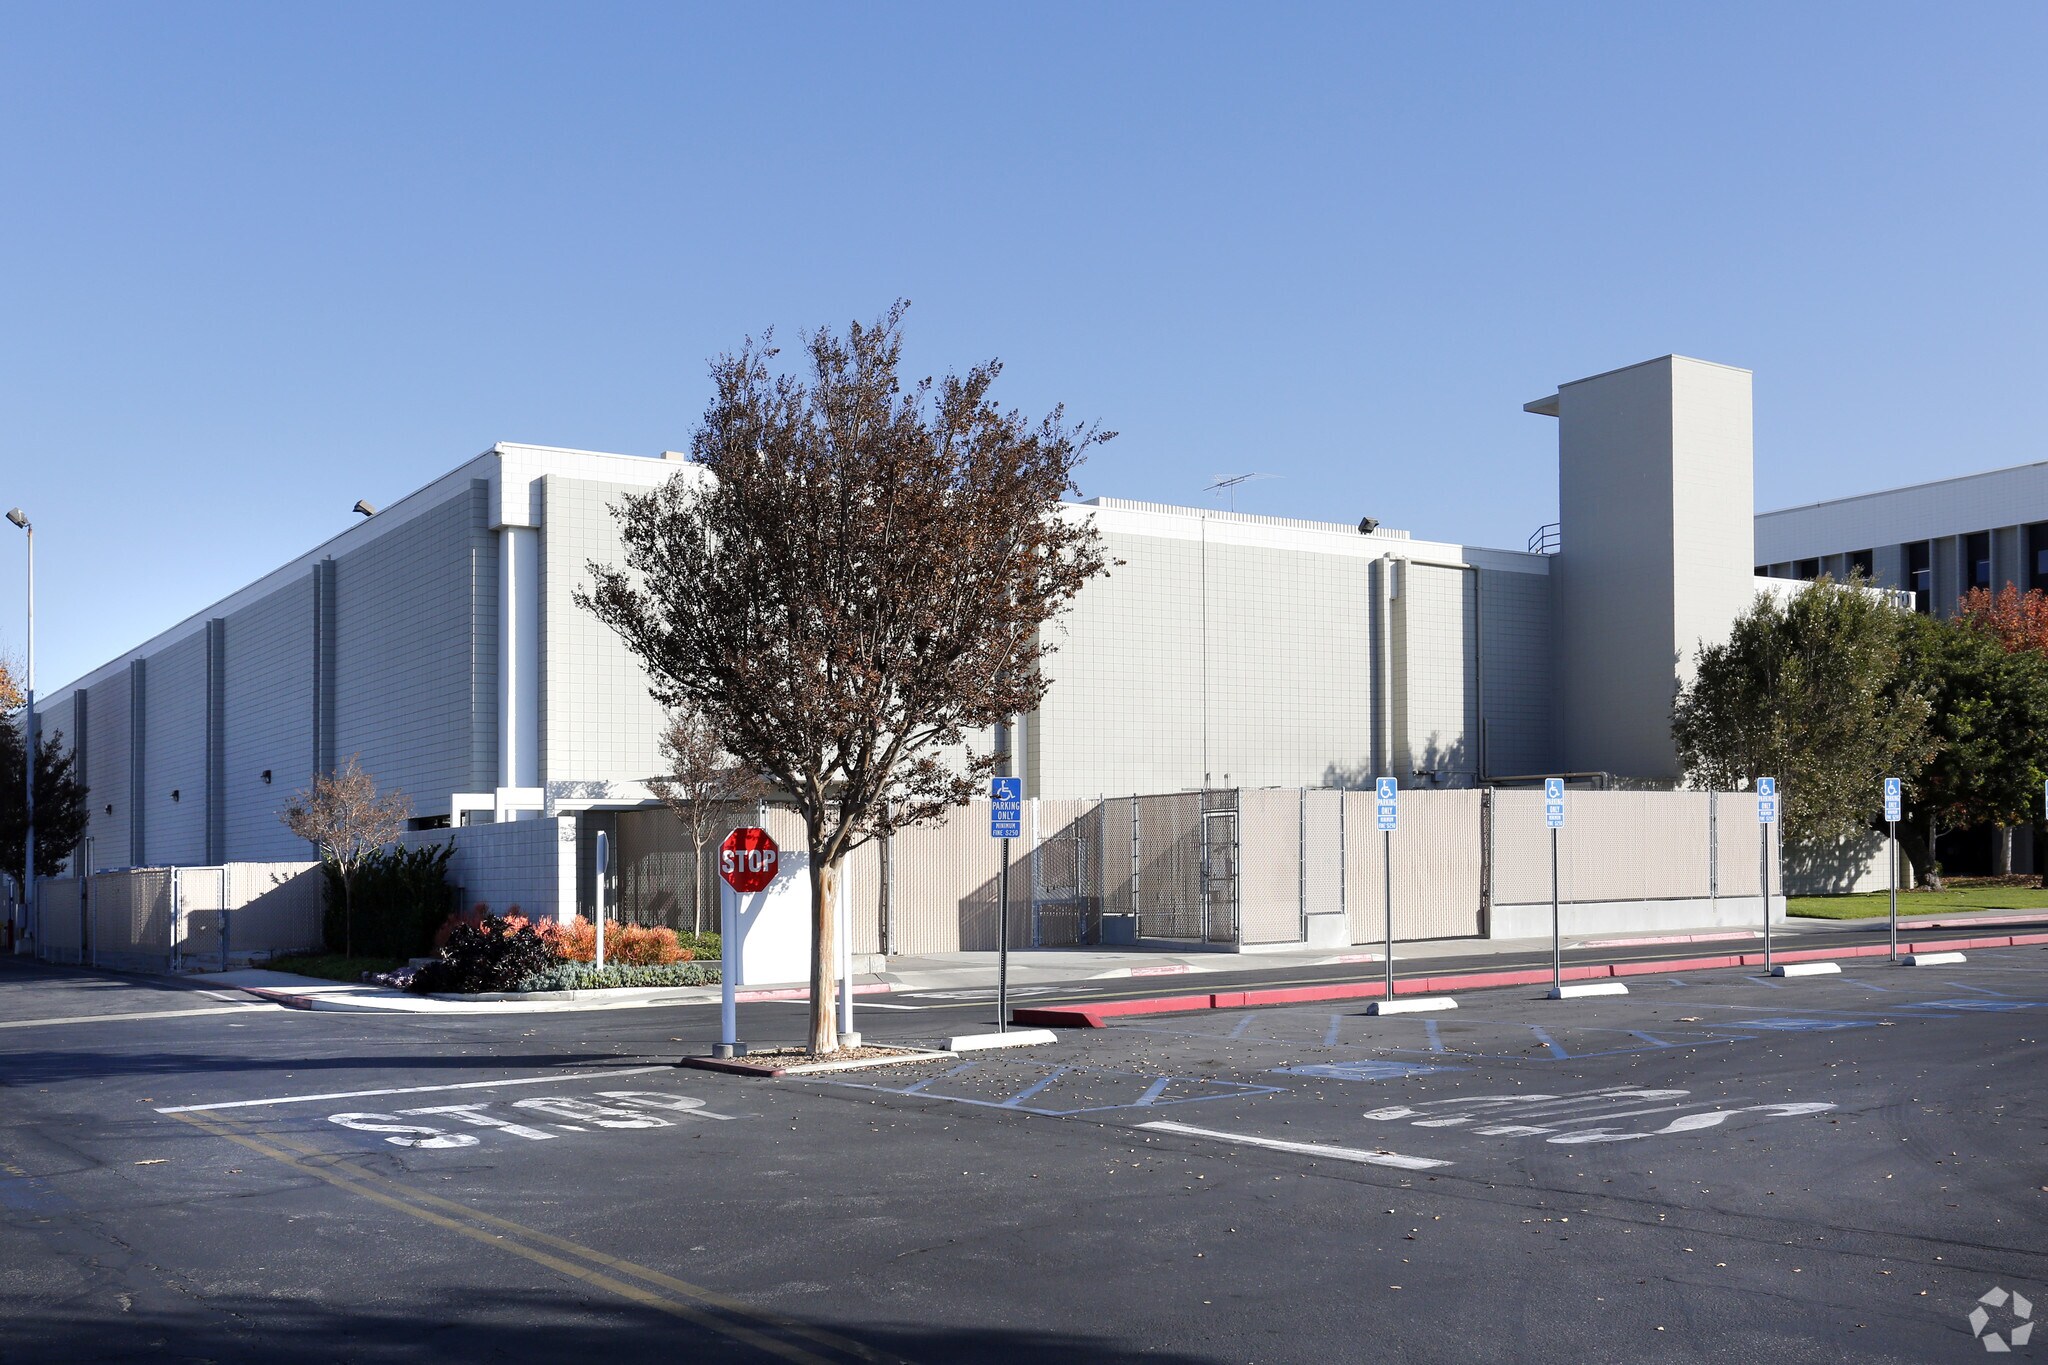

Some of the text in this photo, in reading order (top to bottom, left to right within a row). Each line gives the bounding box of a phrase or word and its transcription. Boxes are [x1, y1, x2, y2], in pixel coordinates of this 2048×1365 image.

[992, 801, 1020, 811] PARKING
[997, 811, 1015, 820] ONLY
[721, 849, 776, 873] STOP
[327, 1091, 737, 1149] STOP
